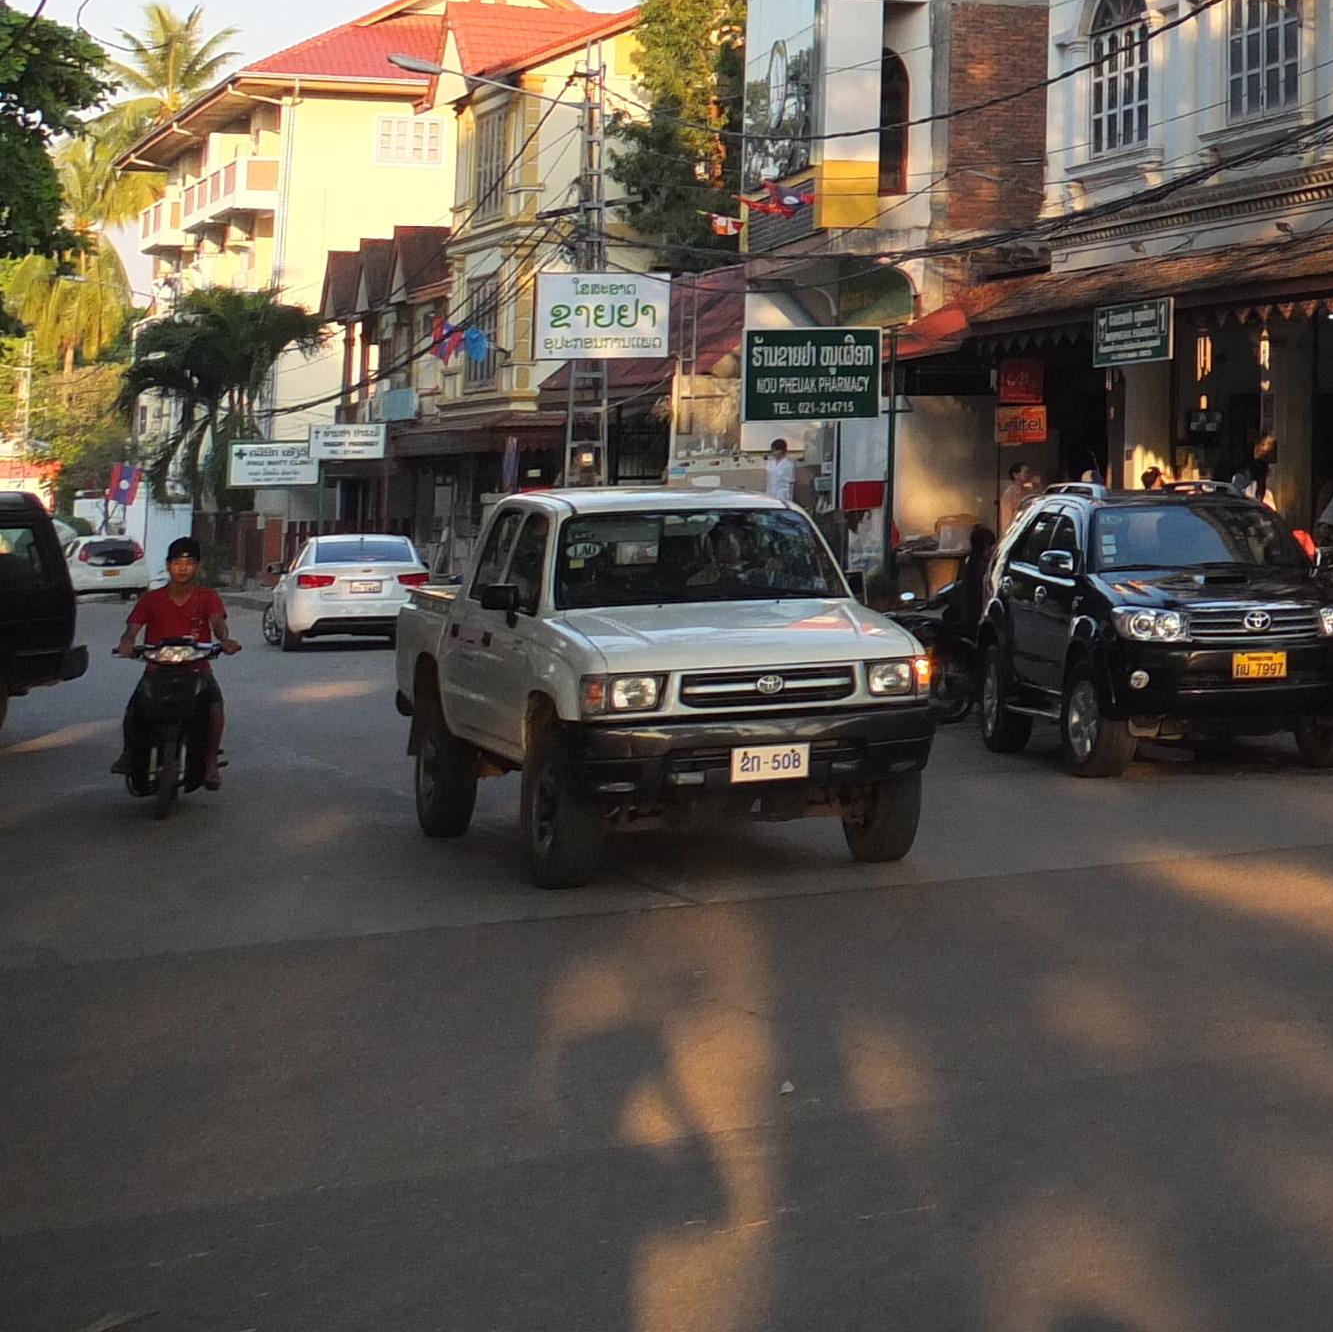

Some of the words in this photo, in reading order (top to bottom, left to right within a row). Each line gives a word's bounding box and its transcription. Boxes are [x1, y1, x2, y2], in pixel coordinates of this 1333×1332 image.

[550, 298, 657, 328] ຂາຍຢາ
[756, 377, 778, 393] NOU
[779, 377, 816, 393] PHEUAK
[818, 376, 870, 393] PHARMACY
